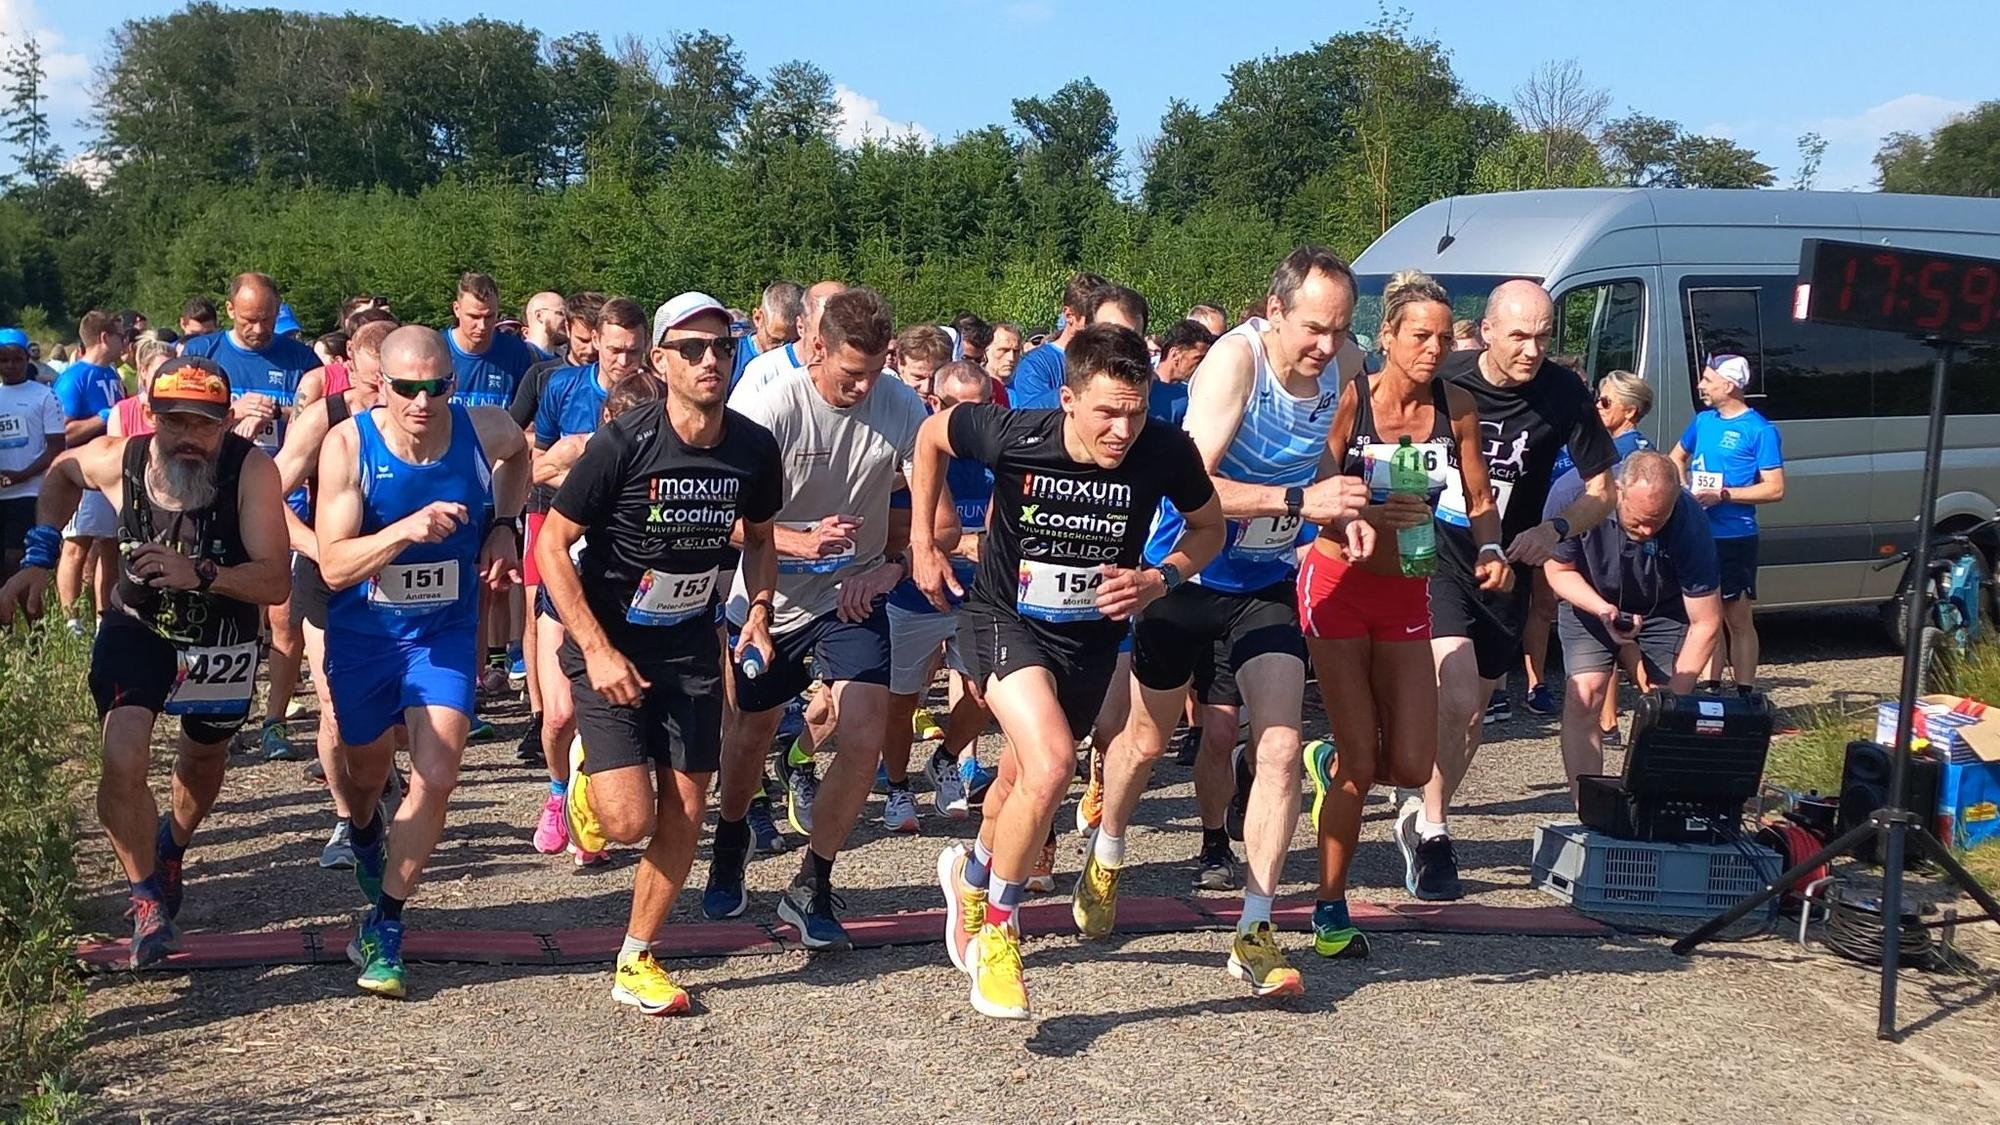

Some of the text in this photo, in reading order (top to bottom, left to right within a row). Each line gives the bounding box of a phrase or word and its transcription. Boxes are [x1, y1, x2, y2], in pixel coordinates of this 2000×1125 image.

[1396, 448, 1438, 473] 116
[658, 477, 740, 495] maxum
[1032, 474, 1132, 502] maxum
[401, 567, 445, 590] 151
[672, 575, 711, 599] 153
[1054, 571, 1104, 594] 154
[186, 652, 252, 685] 422
